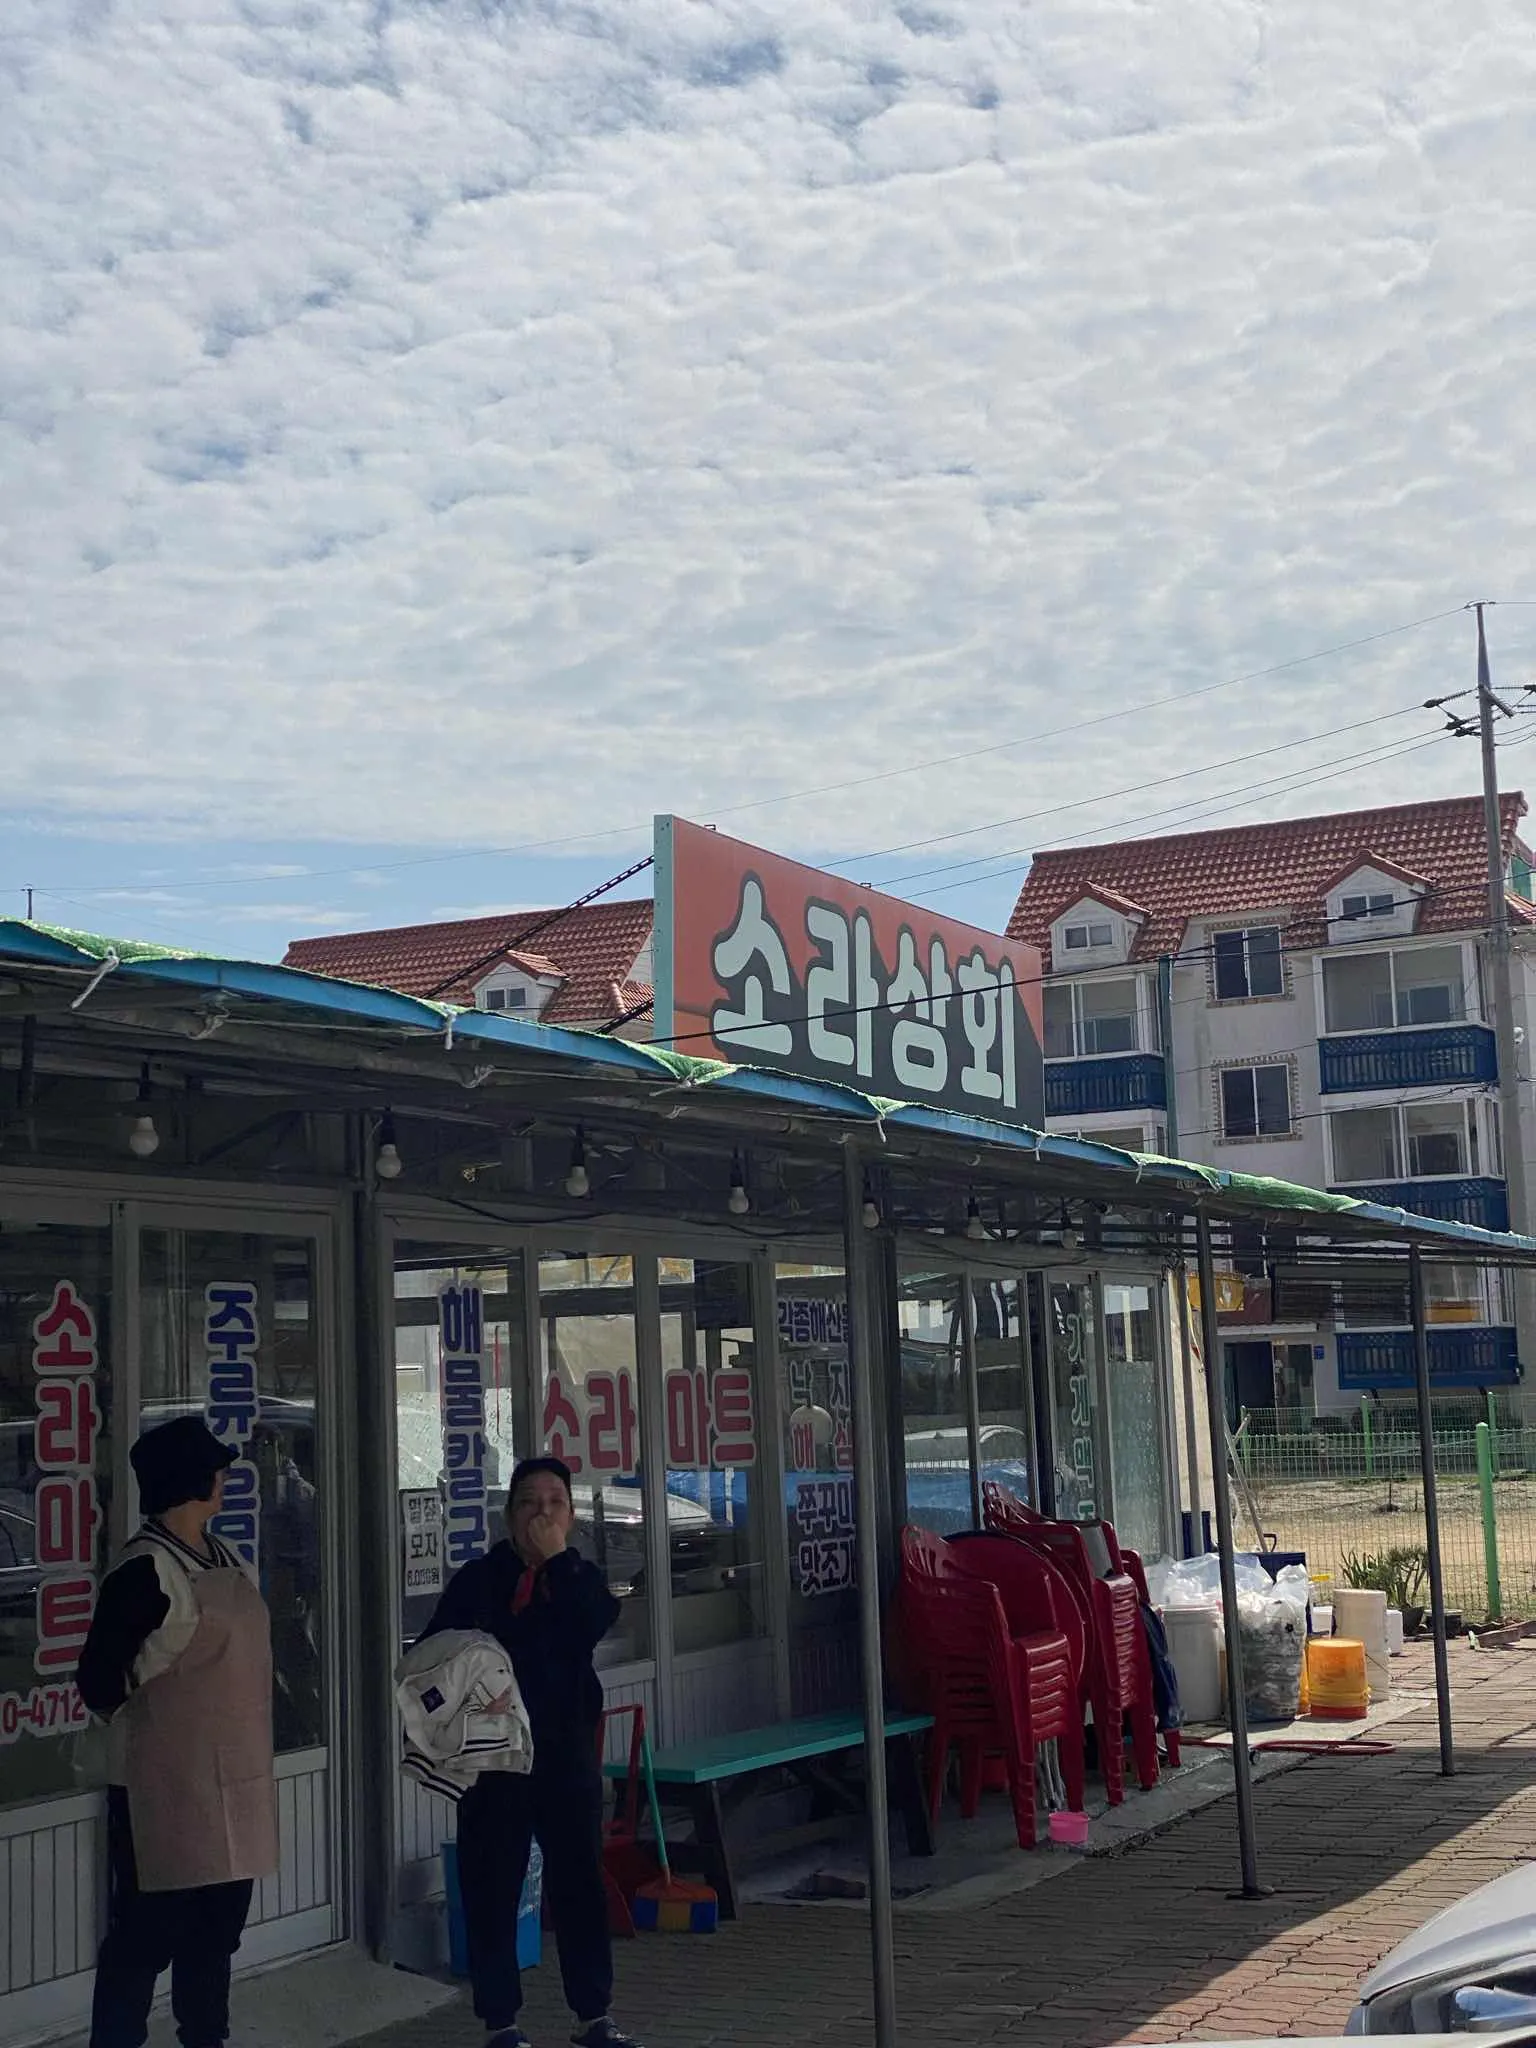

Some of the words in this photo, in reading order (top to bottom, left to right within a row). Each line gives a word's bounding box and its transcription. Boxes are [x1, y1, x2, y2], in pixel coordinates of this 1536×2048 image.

[713, 880, 1016, 1109] 소라상회
[36, 1286, 97, 1666] 소라마트
[410, 1530, 439, 1559] 모자
